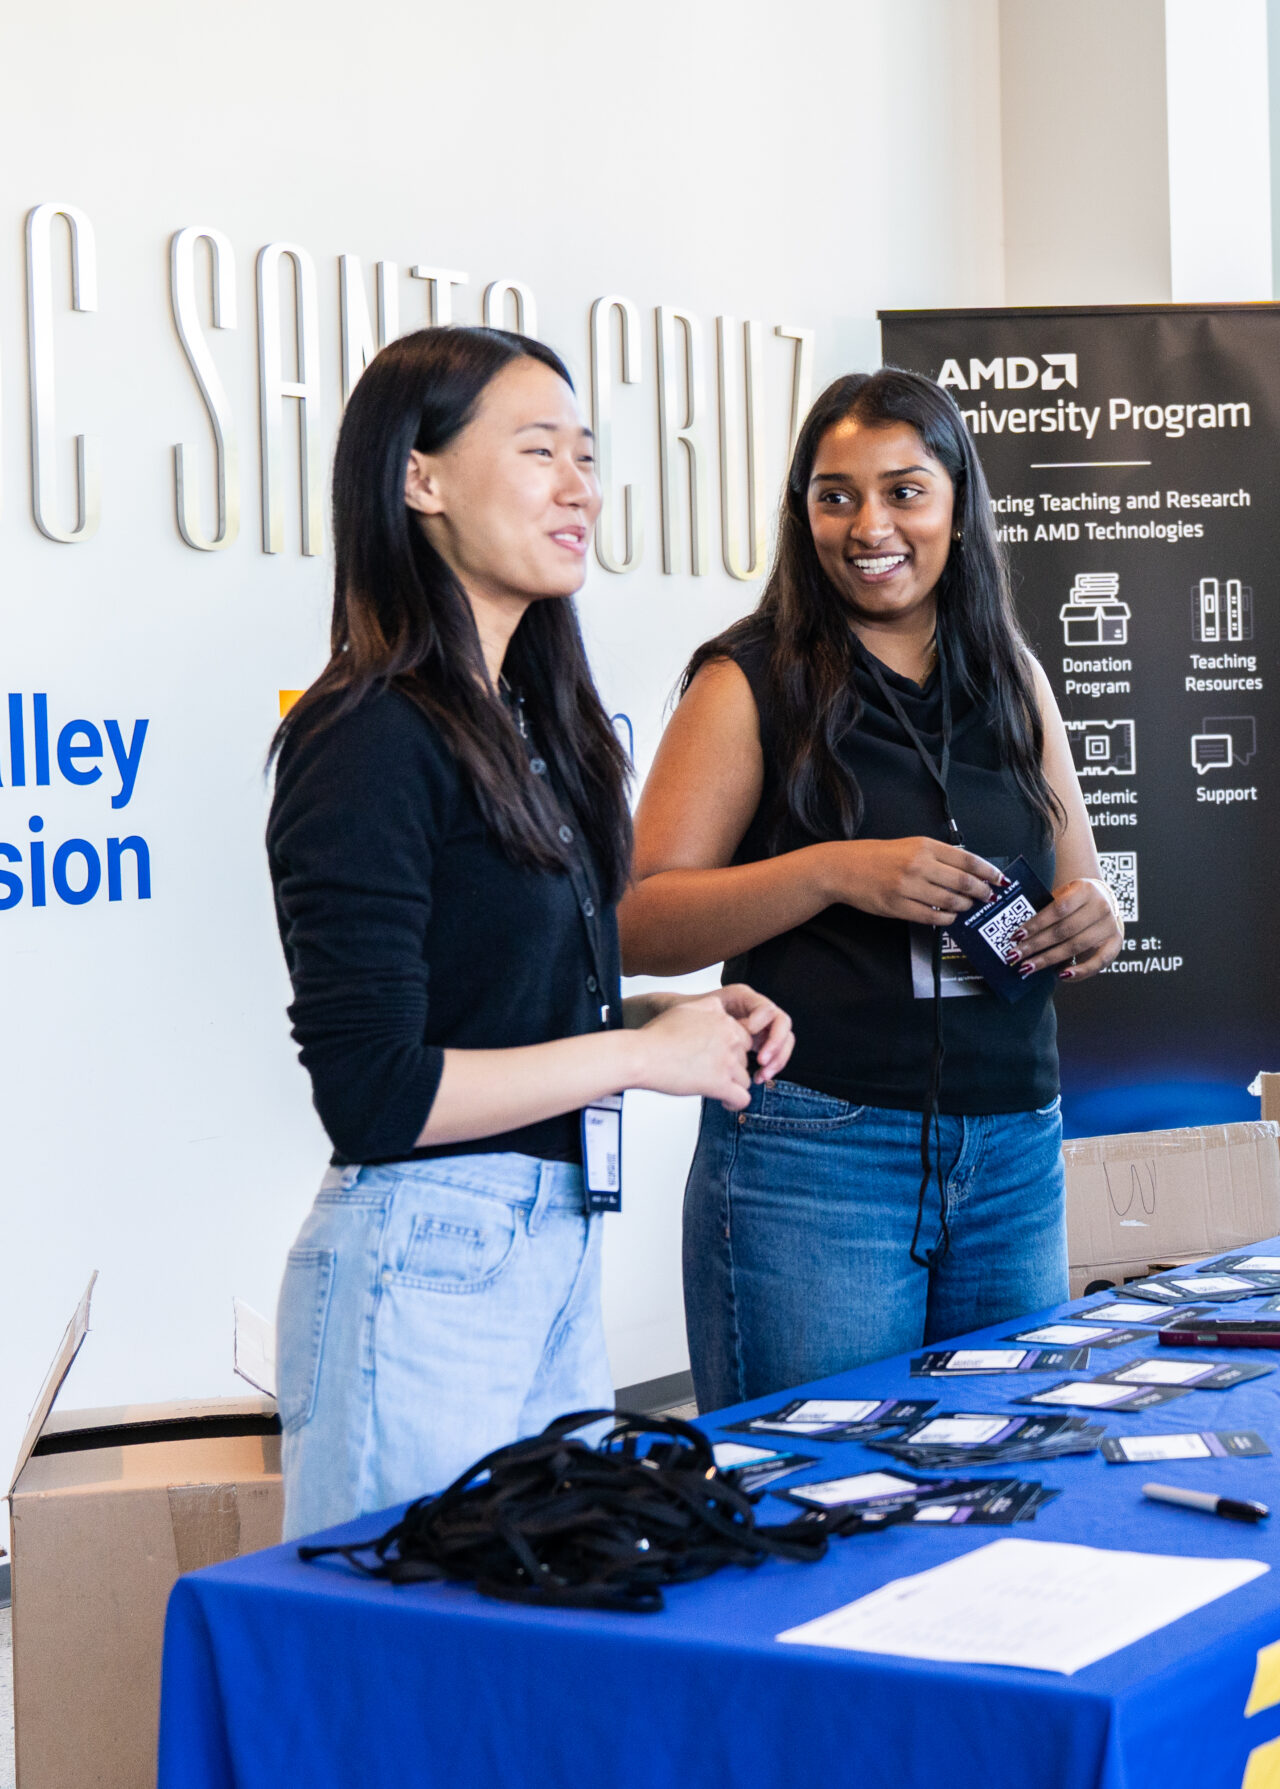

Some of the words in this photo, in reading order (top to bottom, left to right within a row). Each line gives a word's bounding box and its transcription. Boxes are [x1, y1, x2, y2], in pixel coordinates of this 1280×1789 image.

[18, 202, 101, 543] C
[936, 357, 1039, 390] AMD
[960, 399, 1100, 439] niversity
[1109, 398, 1251, 437] Program
[1040, 492, 1121, 514] Teaching
[1126, 490, 1160, 511] and
[1166, 489, 1251, 509] Research
[1034, 523, 1080, 541] AMD
[1085, 521, 1204, 543] Technologies
[1063, 657, 1132, 673] Donation
[1190, 654, 1257, 671] Teaching
[1065, 680, 1131, 697] Program
[1185, 676, 1263, 691] Resources
[0, 692, 149, 809] lley
[1196, 786, 1258, 804] Support
[964, 894, 1003, 926] EVERYTHIG
[1141, 936, 1162, 951] at:
[1098, 956, 1184, 974] .com/AUP
